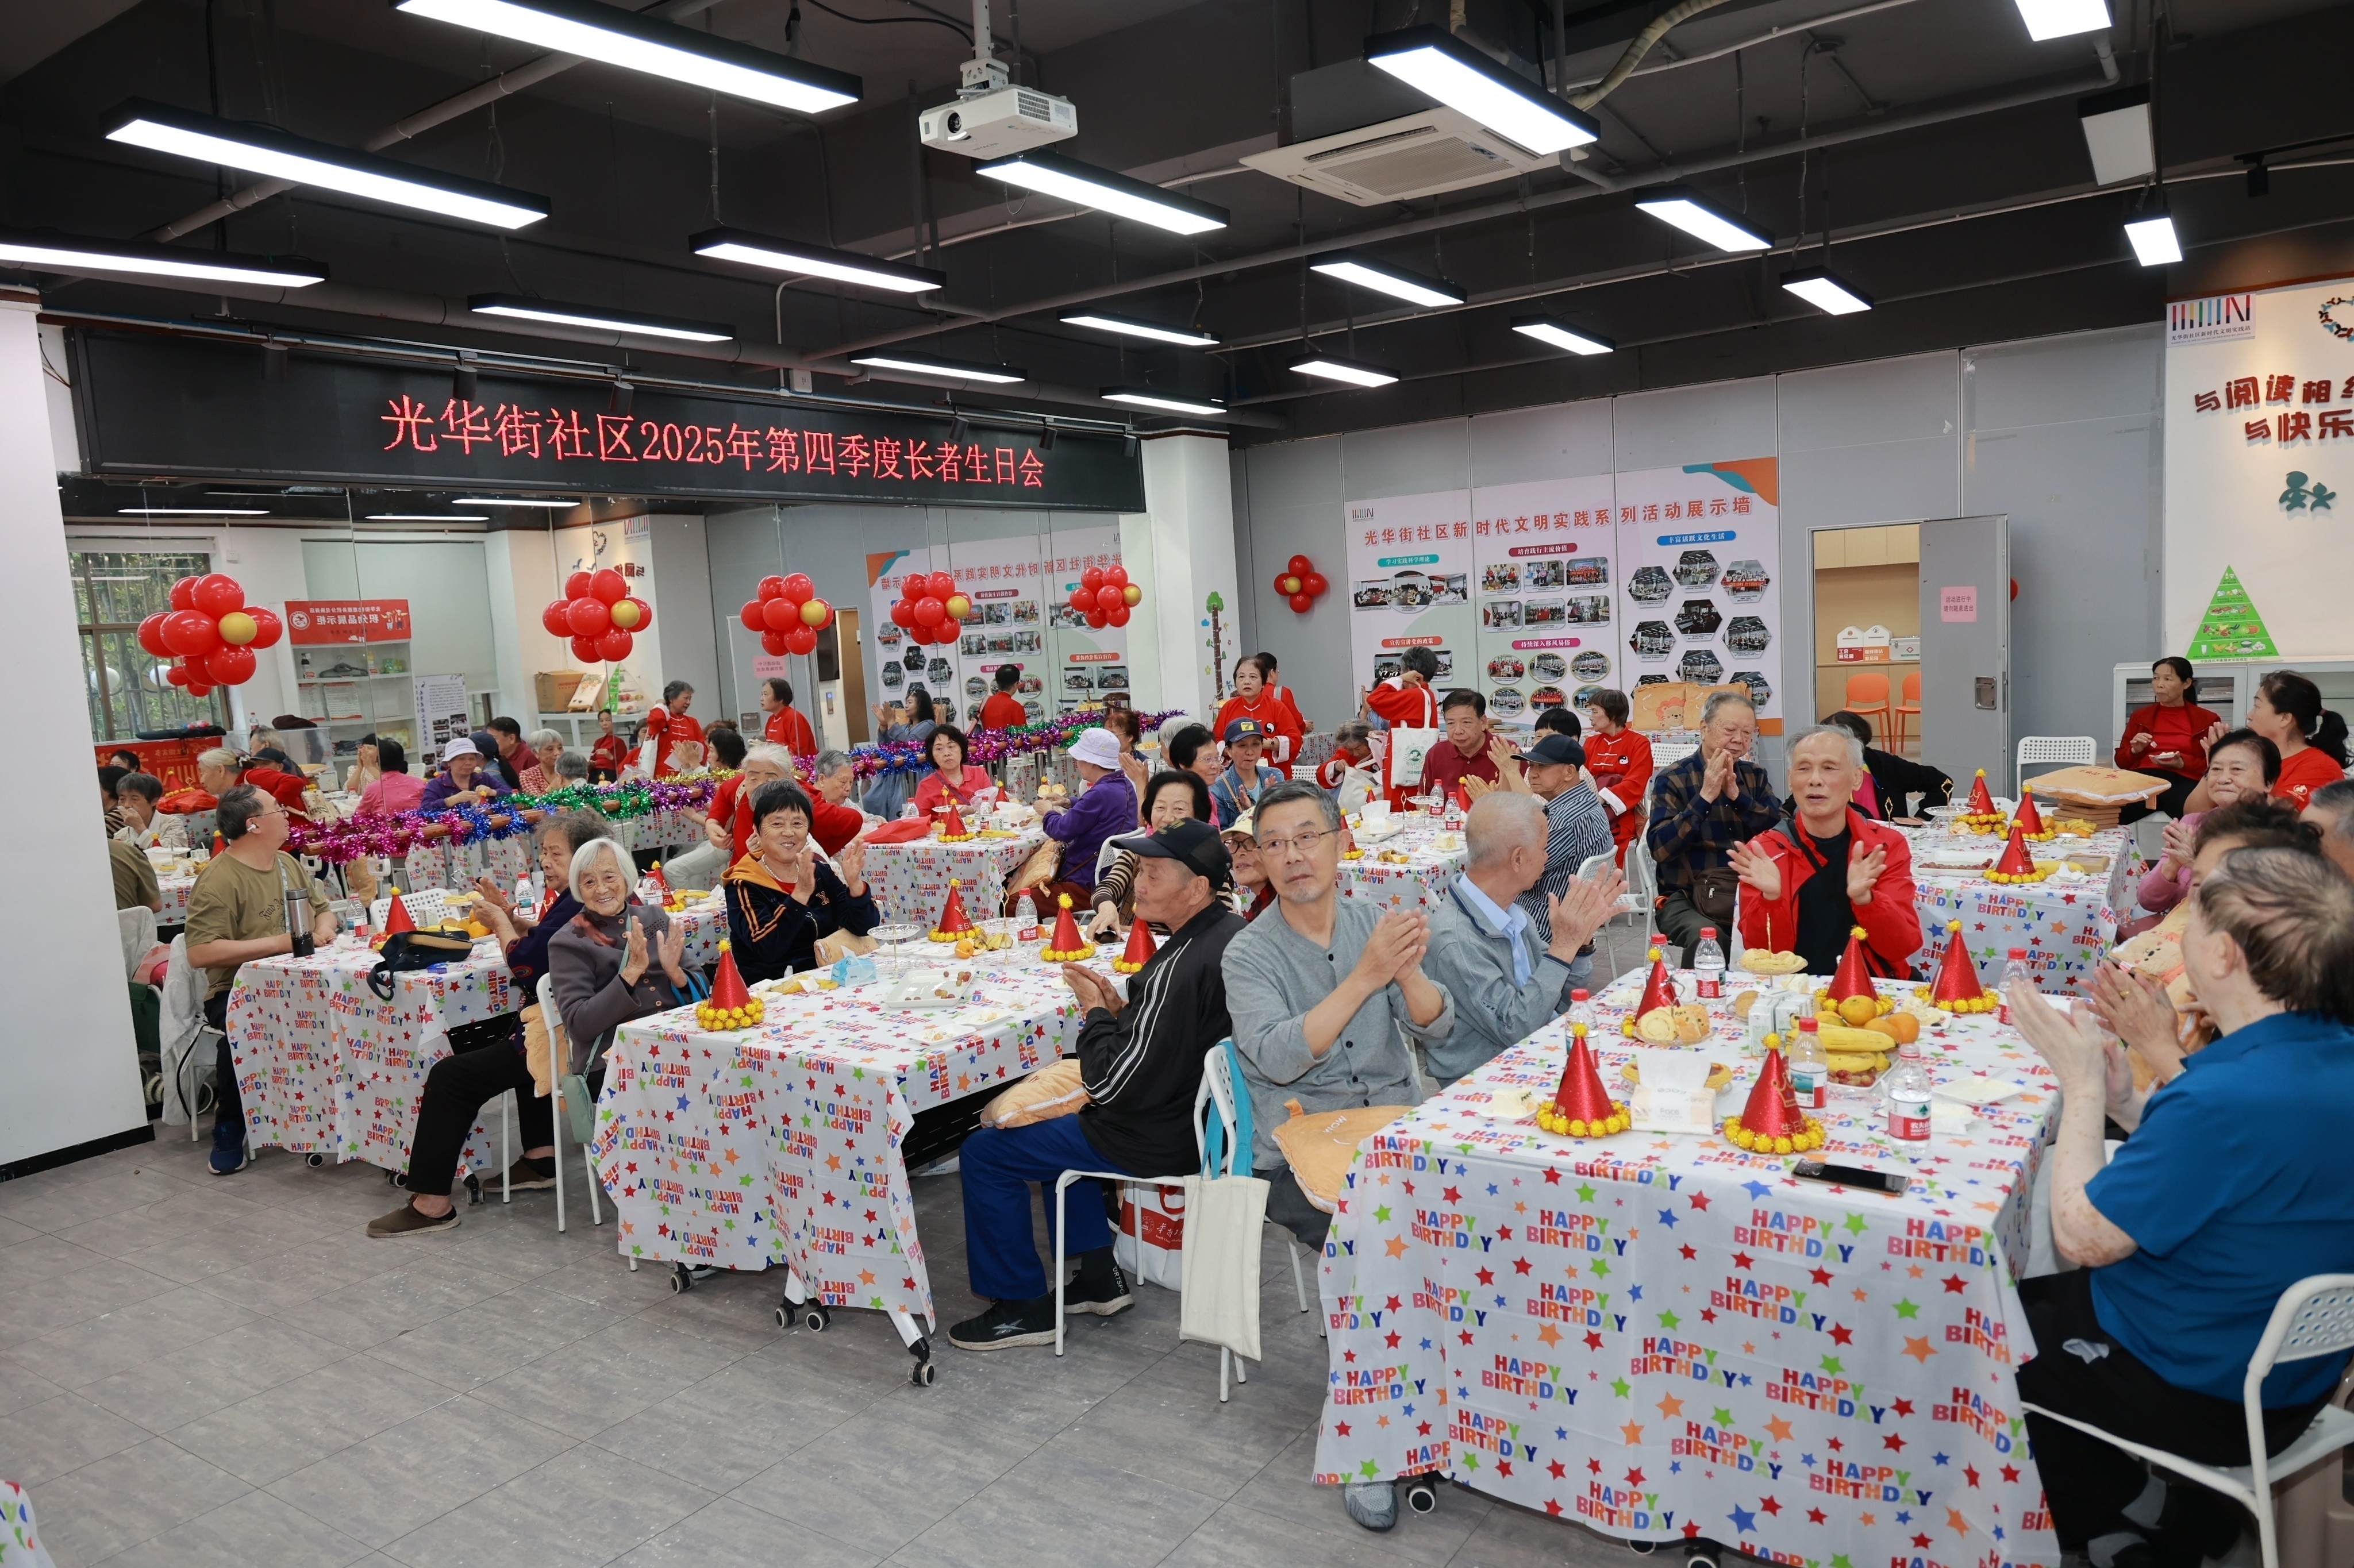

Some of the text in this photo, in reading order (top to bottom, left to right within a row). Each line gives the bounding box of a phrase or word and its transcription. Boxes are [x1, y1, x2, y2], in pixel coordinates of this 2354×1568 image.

[2171, 326, 2251, 341] 光华街社区新时代文明实践站
[380, 394, 1045, 488] 光华街社区2025年第四季度长者生日会
[1364, 495, 1752, 546] 光华街社区新时代文明实践系列活动展示墙
[1668, 533, 1725, 543] 丰富活跃文化生活
[1517, 545, 1567, 554] 培育践行主流价值
[1386, 556, 1430, 565] 学习实践科学理论
[1389, 638, 1434, 646] 宣传宣讲党的政策
[1521, 640, 1570, 648] 持续深入移风易俗
[1989, 895, 2034, 910] HAPPY
[1978, 904, 2045, 920] BIRTHDAY
[302, 970, 322, 978] HAPPY
[265, 980, 284, 988] HAPPY
[300, 980, 330, 988] BIRTHDAY
[264, 989, 291, 998] BIRTHDAY
[333, 992, 365, 1007] HAPPY
[498, 976, 509, 1013] HAPPY
[297, 1011, 317, 1020] HAPPY
[251, 1023, 267, 1031] HAPPY
[295, 1020, 325, 1029] BIRTHDAY
[347, 1038, 376, 1052] HAPPY
[657, 1032, 688, 1043] HAPPY
[837, 1037, 897, 1050] BIRTHDAY
[291, 1043, 312, 1051] HAPPY
[389, 1048, 416, 1060] HAPPY
[836, 1043, 878, 1051] HAPPY
[288, 1052, 320, 1061] BIRTHDAY
[384, 1057, 425, 1069] BIRTHDAY
[792, 1050, 851, 1064] BIRTHDAY
[272, 1067, 290, 1077] HAPPY
[641, 1062, 691, 1076] BIRTHDAY
[731, 1058, 764, 1073] HAPPY
[798, 1057, 834, 1074] HAPPY
[272, 1075, 295, 1086] BIRTHDAY
[649, 1074, 684, 1088] HAPPY
[709, 1093, 756, 1107] BIRTHDAY
[290, 1105, 313, 1114] HAPPY
[713, 1105, 752, 1119] HAPPY
[814, 1100, 871, 1122] BIRTHDAY
[372, 1122, 399, 1139] HAPPY
[823, 1115, 863, 1134] HAPPY
[367, 1131, 404, 1149] BIRTHDAY
[621, 1138, 658, 1151] HAPPY
[668, 1134, 710, 1150] BIRTHDAY
[771, 1126, 817, 1149] BIRTHDAY
[1452, 1132, 1548, 1150] BIRTHDAY
[1470, 1130, 1539, 1142] HAPPY
[291, 1142, 317, 1151] HAPPY
[779, 1141, 813, 1160] HAPPY
[1374, 1135, 1433, 1155] HAPPY
[676, 1147, 706, 1162] HAPPY
[1366, 1151, 1449, 1175] BIRTHDAY
[1575, 1162, 1683, 1191] BIRTHDAY
[638, 1178, 684, 1195] BIRTHDAY
[650, 1189, 681, 1205] HAPPY
[695, 1188, 743, 1203] BIRTHDAY
[705, 1200, 739, 1214] HAPPY
[1416, 1209, 1476, 1232] HAPPY
[1540, 1209, 1610, 1235] HAPPY
[1752, 1209, 1834, 1239] HAPPY
[671, 1230, 718, 1247] BIRTHDAY
[803, 1219, 855, 1244] BIRTHDAY
[1411, 1222, 1493, 1253] BIRTHDAY
[1906, 1218, 1994, 1250] HAPPY
[807, 1236, 845, 1255] HAPPY
[1526, 1226, 1628, 1257] BIRTHDAY
[1734, 1226, 1854, 1263] BIRTHDAY
[680, 1243, 714, 1258] HAPPY
[1424, 1276, 1471, 1305] HAPPY
[1540, 1282, 1610, 1310] HAPPY
[1726, 1277, 1807, 1308] HAPPY
[1413, 1292, 1487, 1327] BIRTHDAY
[1526, 1299, 1628, 1333] BIRTHDAY
[1710, 1290, 1827, 1332] BIRTHDAY
[1643, 1337, 1718, 1365] HAPPY
[1347, 1364, 1409, 1386] HAPPY
[1495, 1354, 1560, 1384] HAPPY
[1631, 1353, 1737, 1389] BIRTHDAY
[1334, 1379, 1426, 1405] BIRTHDAY
[1482, 1370, 1578, 1405] BIRTHDAY
[1782, 1368, 1864, 1400] HAPPY
[1766, 1382, 1885, 1424] BIRTHDAY
[1952, 1386, 2024, 1439] HAPPY
[1458, 1409, 1520, 1439] HAPPY
[1449, 1424, 1538, 1462] BIRTHDAY
[1686, 1420, 1764, 1457] HAPPY
[1671, 1438, 1783, 1481] BIRTHDAY
[1828, 1459, 1911, 1488] HAPPY
[1590, 1480, 1659, 1511] HAPPY
[1810, 1474, 1933, 1506] BIRTHDAY
[1576, 1495, 1674, 1531] BIRTHDAY
